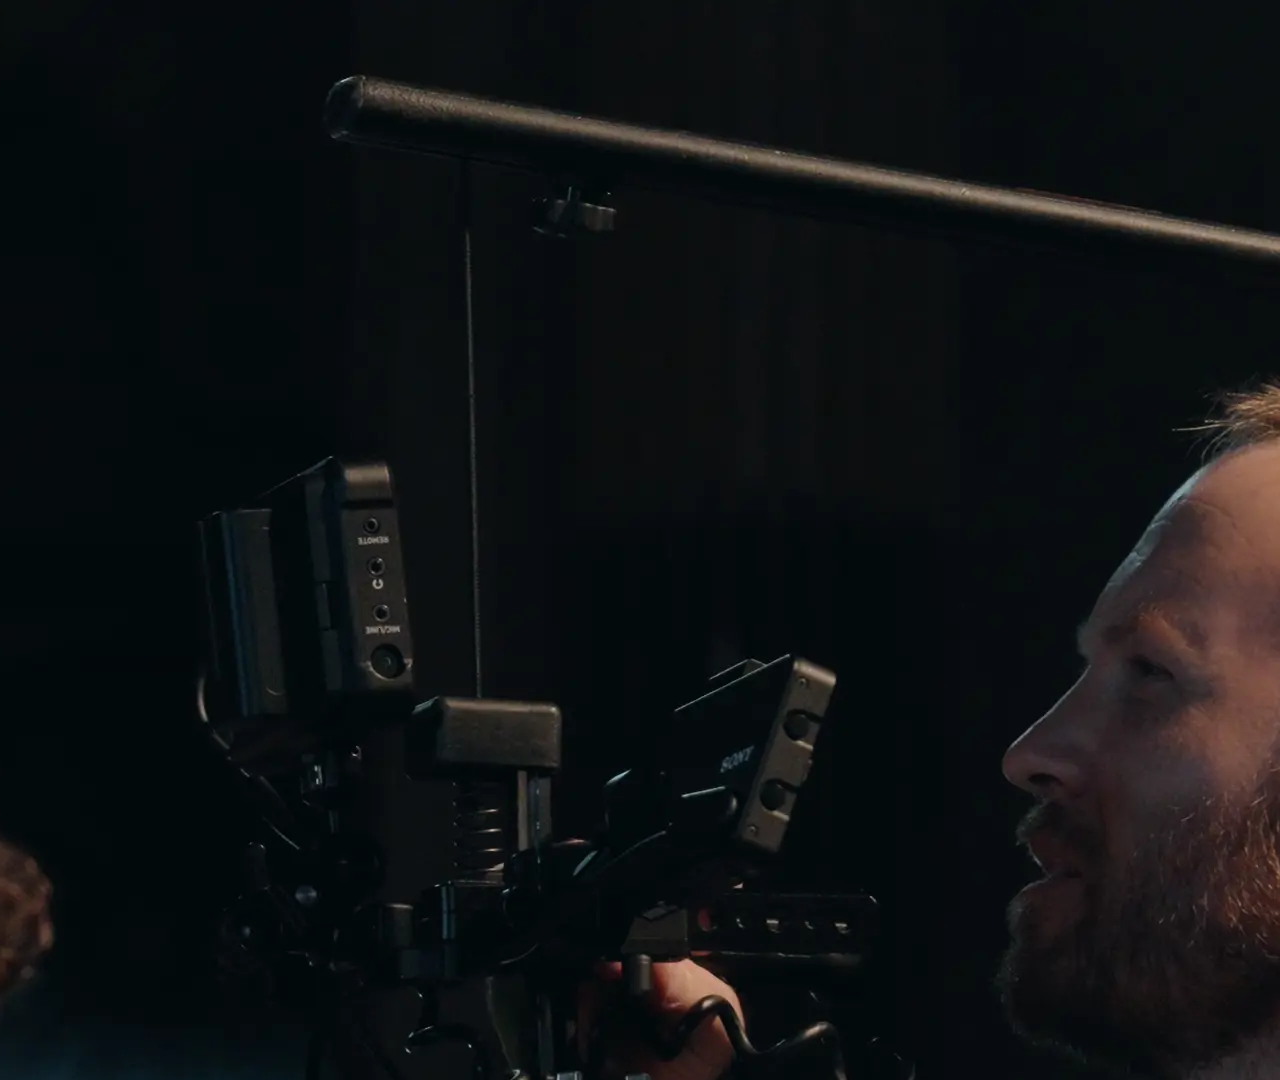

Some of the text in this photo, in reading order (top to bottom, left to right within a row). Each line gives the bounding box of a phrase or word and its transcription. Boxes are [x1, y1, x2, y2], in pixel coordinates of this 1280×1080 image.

[357, 536, 390, 546] REMOTE
[365, 626, 401, 636] MIC/LINE
[720, 744, 755, 773] SONY
